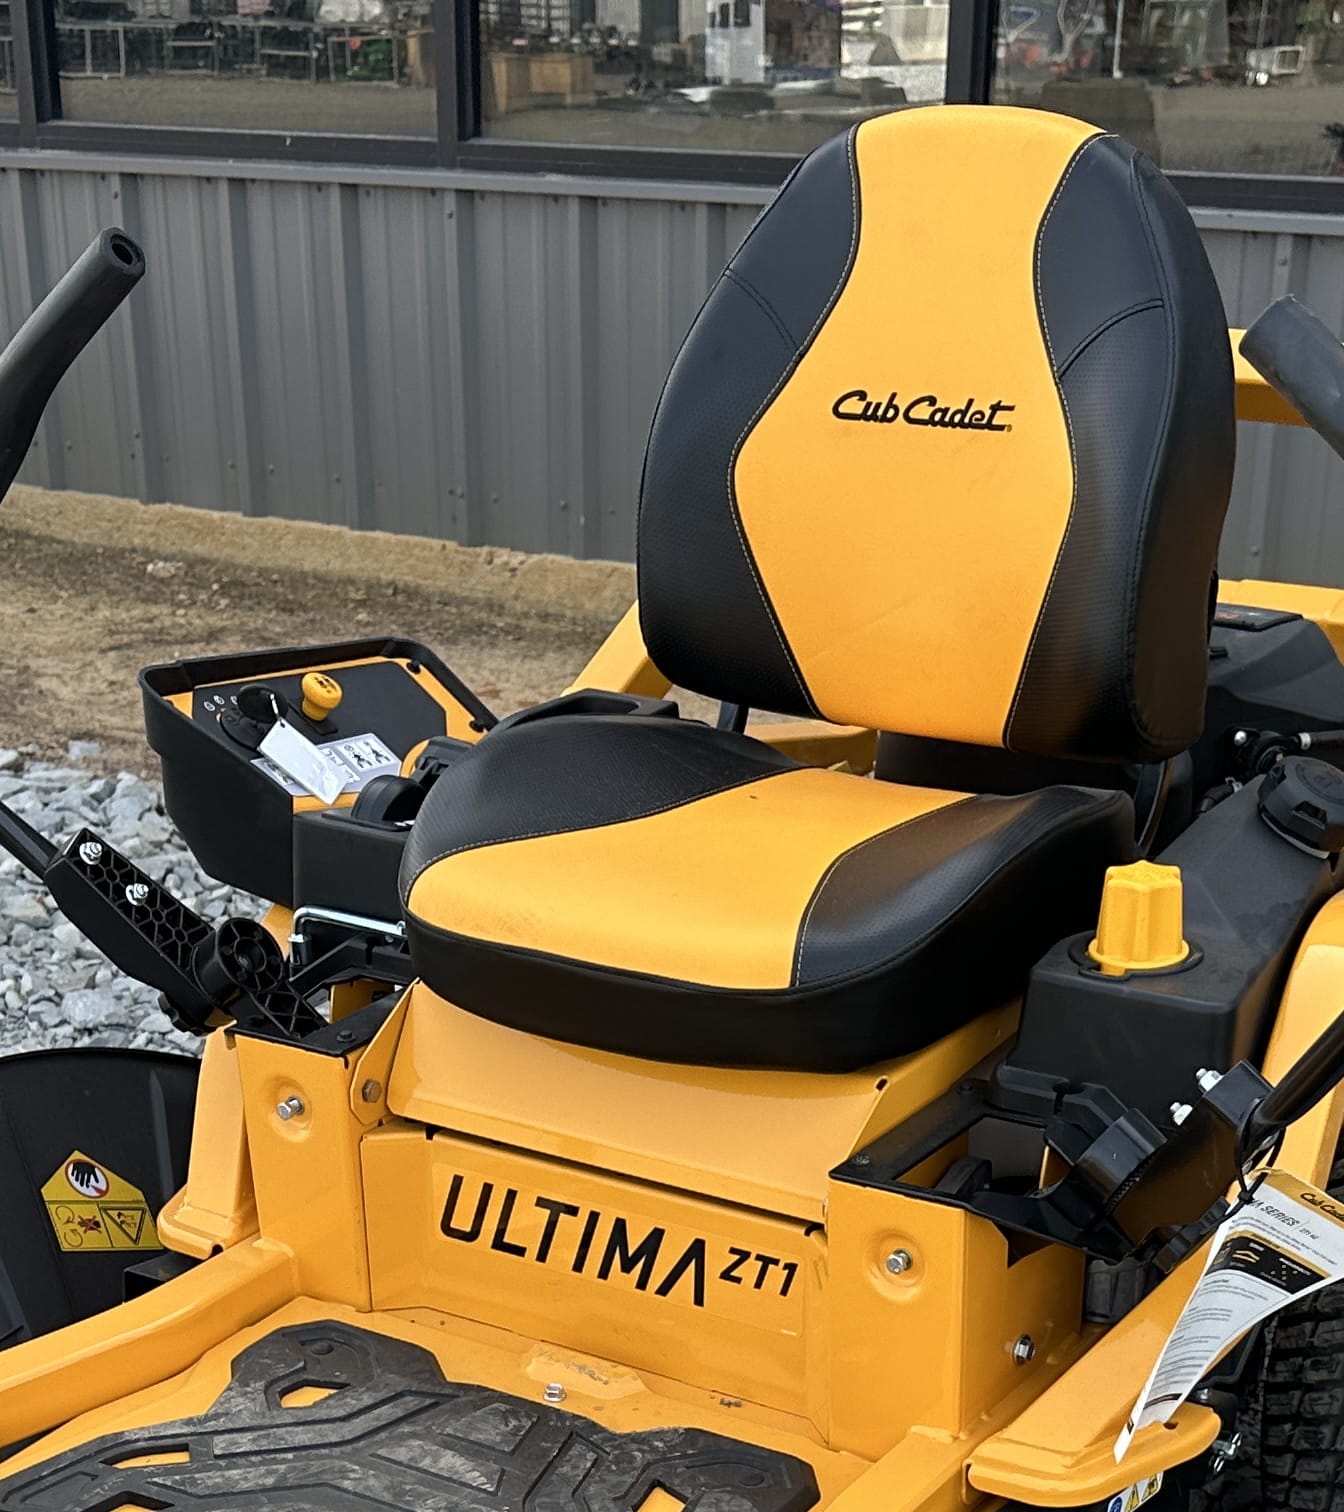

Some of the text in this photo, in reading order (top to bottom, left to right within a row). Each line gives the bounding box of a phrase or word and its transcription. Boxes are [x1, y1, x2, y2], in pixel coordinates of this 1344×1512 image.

[832, 389, 1016, 432] Cub Cadet
[1300, 1192, 1324, 1207] Cub
[1260, 1205, 1301, 1227] SERIES
[440, 1173, 799, 1308] ULTIMA ZT1
